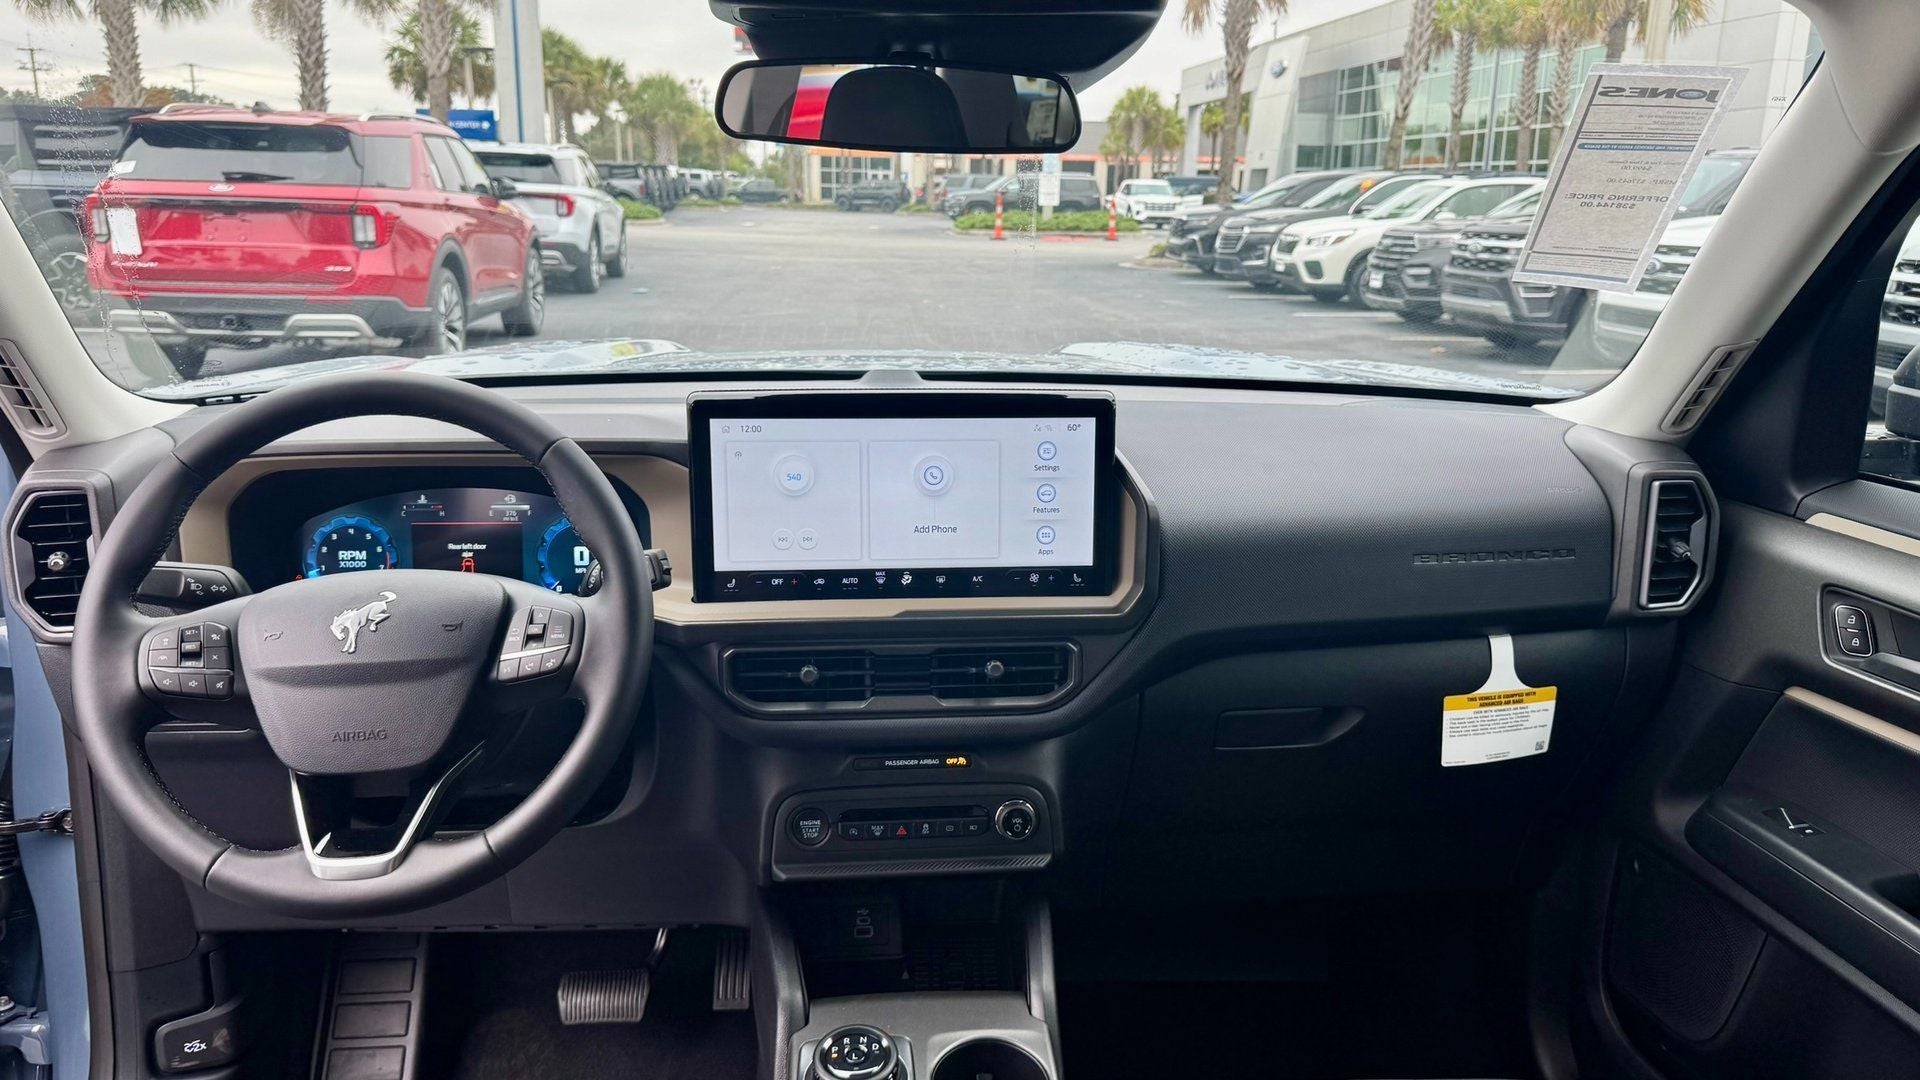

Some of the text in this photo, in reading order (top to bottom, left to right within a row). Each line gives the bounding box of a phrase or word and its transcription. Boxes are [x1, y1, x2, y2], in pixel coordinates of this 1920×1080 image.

[740, 424, 762, 433] 12:00
[1033, 464, 1061, 472] Settings
[786, 473, 802, 481] 540
[913, 525, 958, 533] Add Phone
[338, 550, 367, 560] RPM
[1038, 548, 1054, 556] Apps
[1412, 548, 1576, 565] BRONCO
[332, 729, 388, 742] AIRBAG
